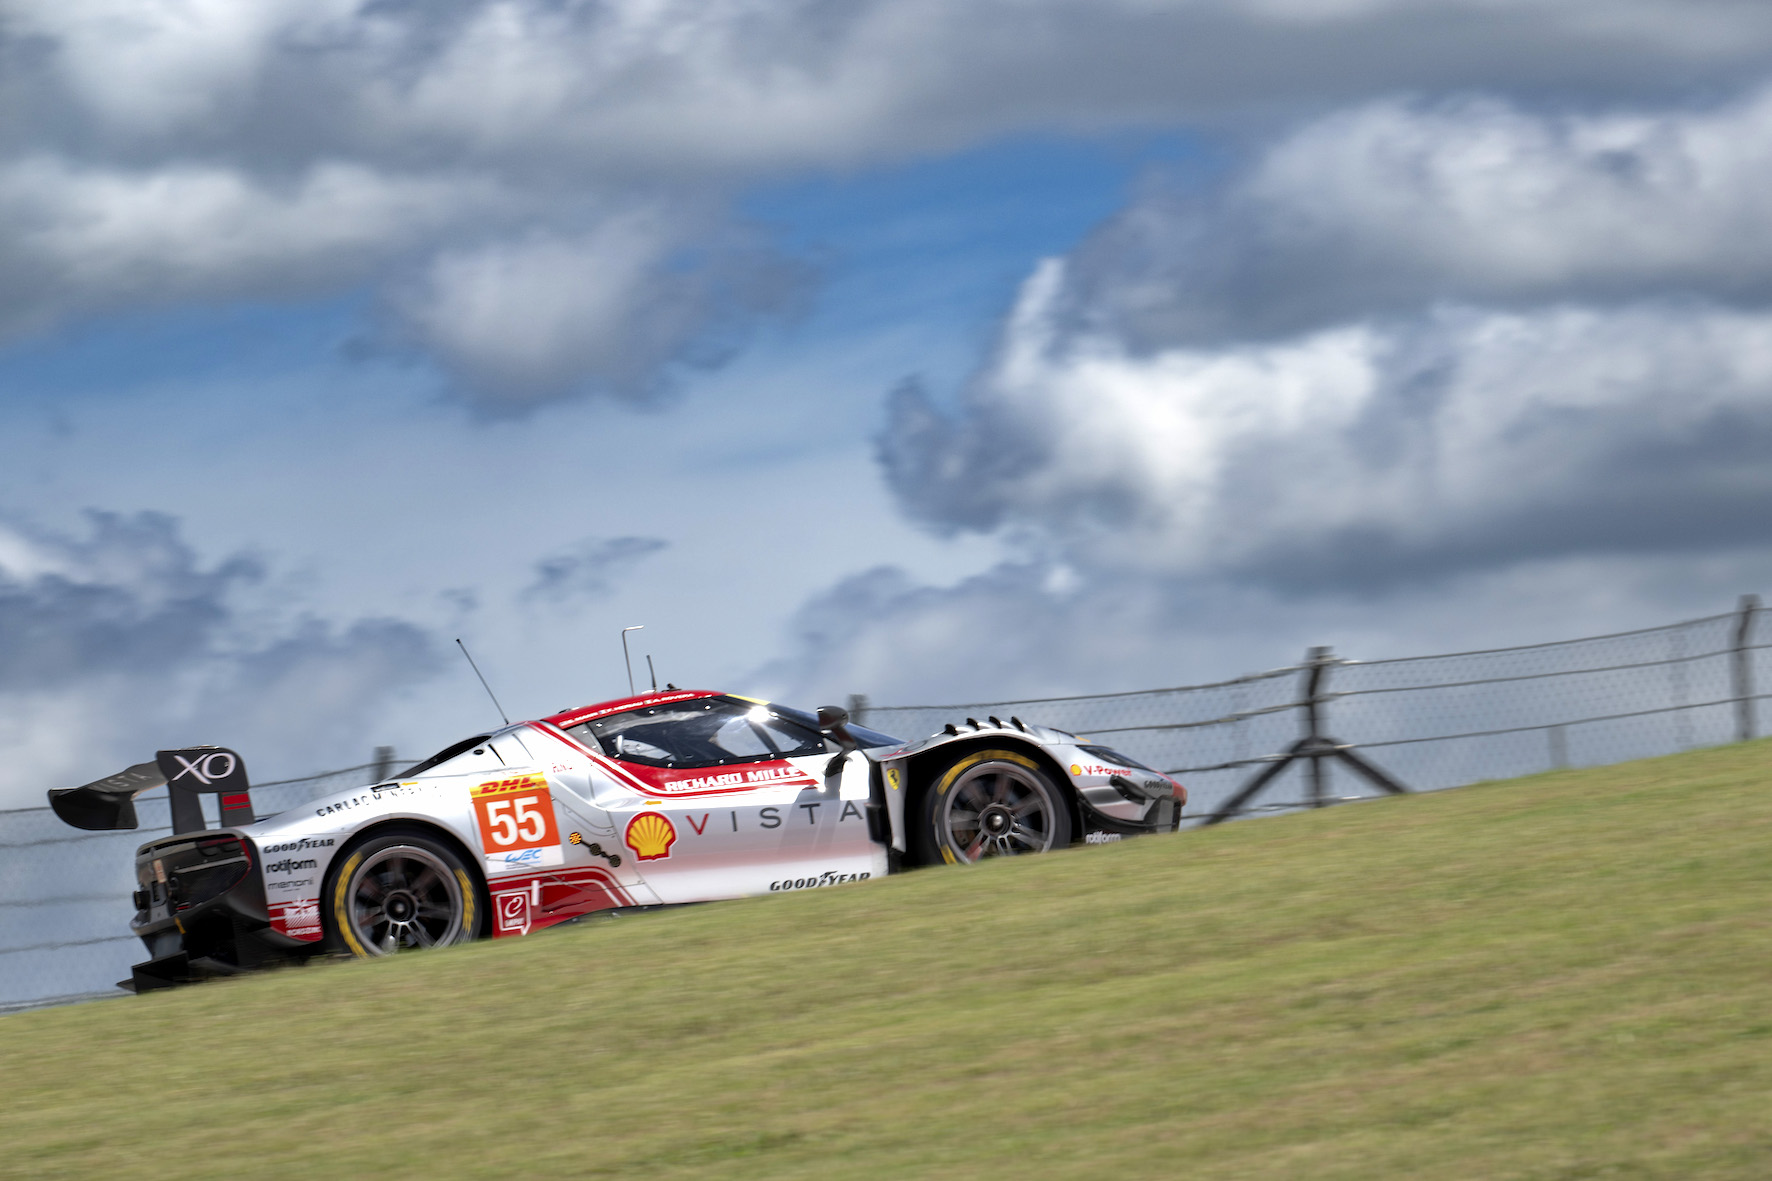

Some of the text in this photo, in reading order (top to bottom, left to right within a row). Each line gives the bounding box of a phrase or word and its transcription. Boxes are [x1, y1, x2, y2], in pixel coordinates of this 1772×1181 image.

[171, 752, 236, 785] XO
[664, 766, 801, 792] RICHARD MILLE
[479, 776, 537, 794] DHL
[485, 795, 547, 846] 55
[685, 800, 865, 836] VISTA
[263, 838, 335, 854] GOODYEAR
[505, 848, 543, 863] WEC
[265, 858, 318, 875] rotiform
